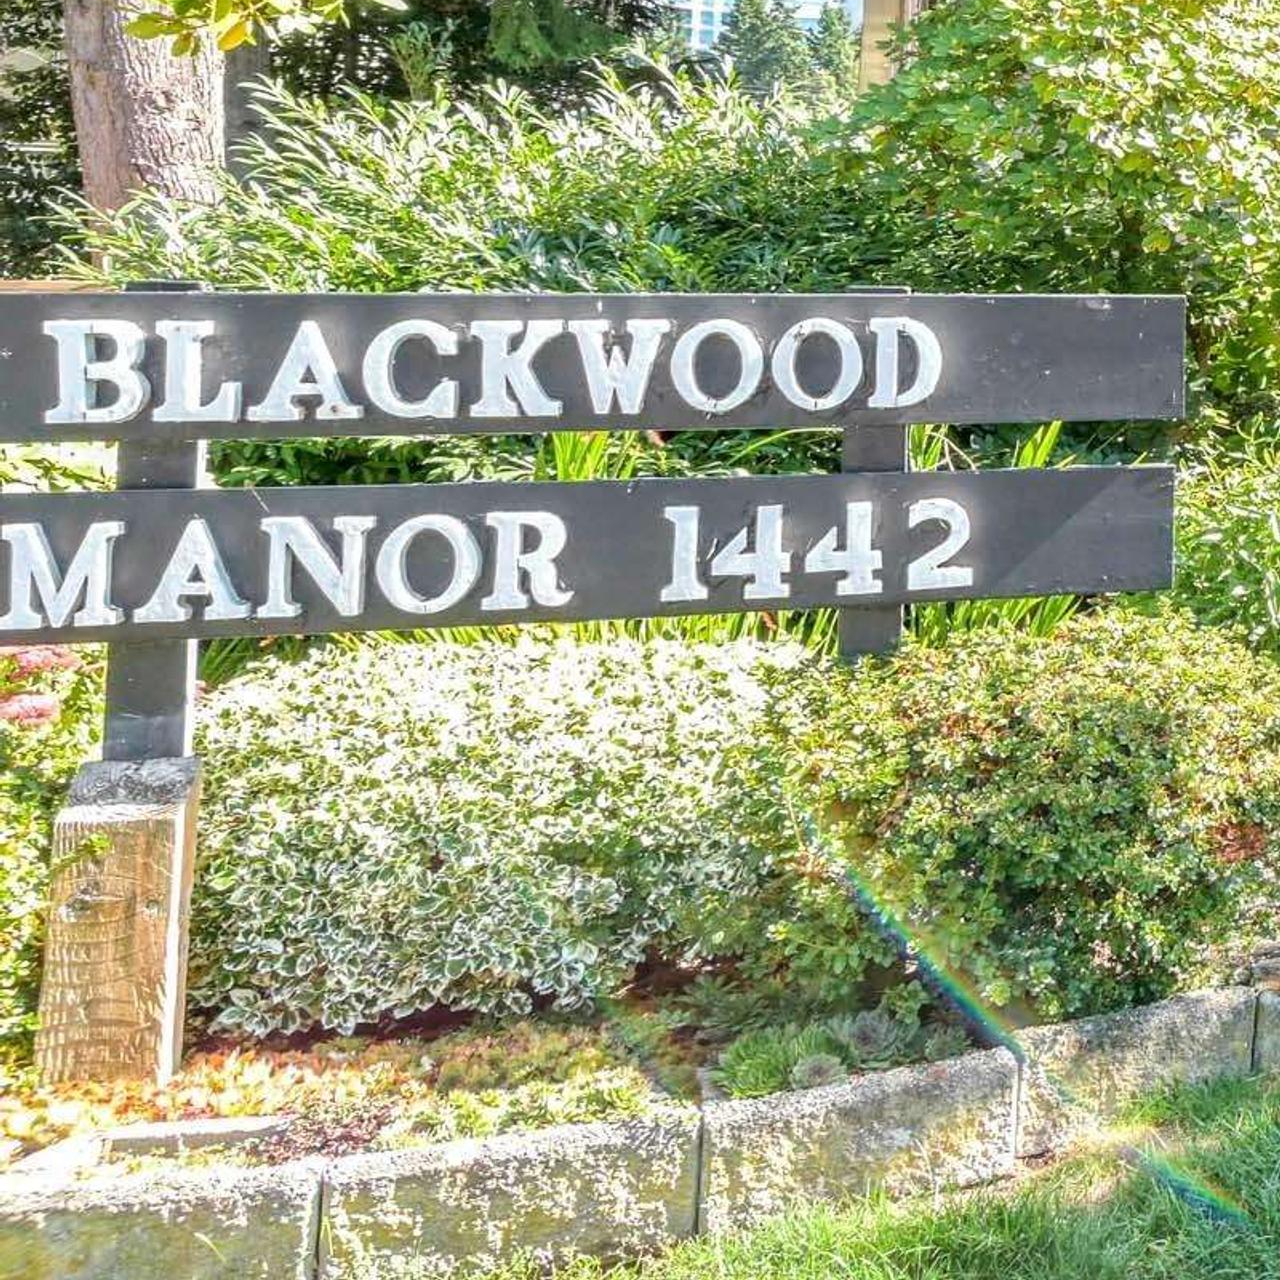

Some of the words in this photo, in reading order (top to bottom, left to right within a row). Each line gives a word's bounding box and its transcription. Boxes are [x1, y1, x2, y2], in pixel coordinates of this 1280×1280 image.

[44, 317, 944, 424] BLACKWOOD
[0, 511, 574, 630] MANOR
[660, 498, 974, 602] 1442
